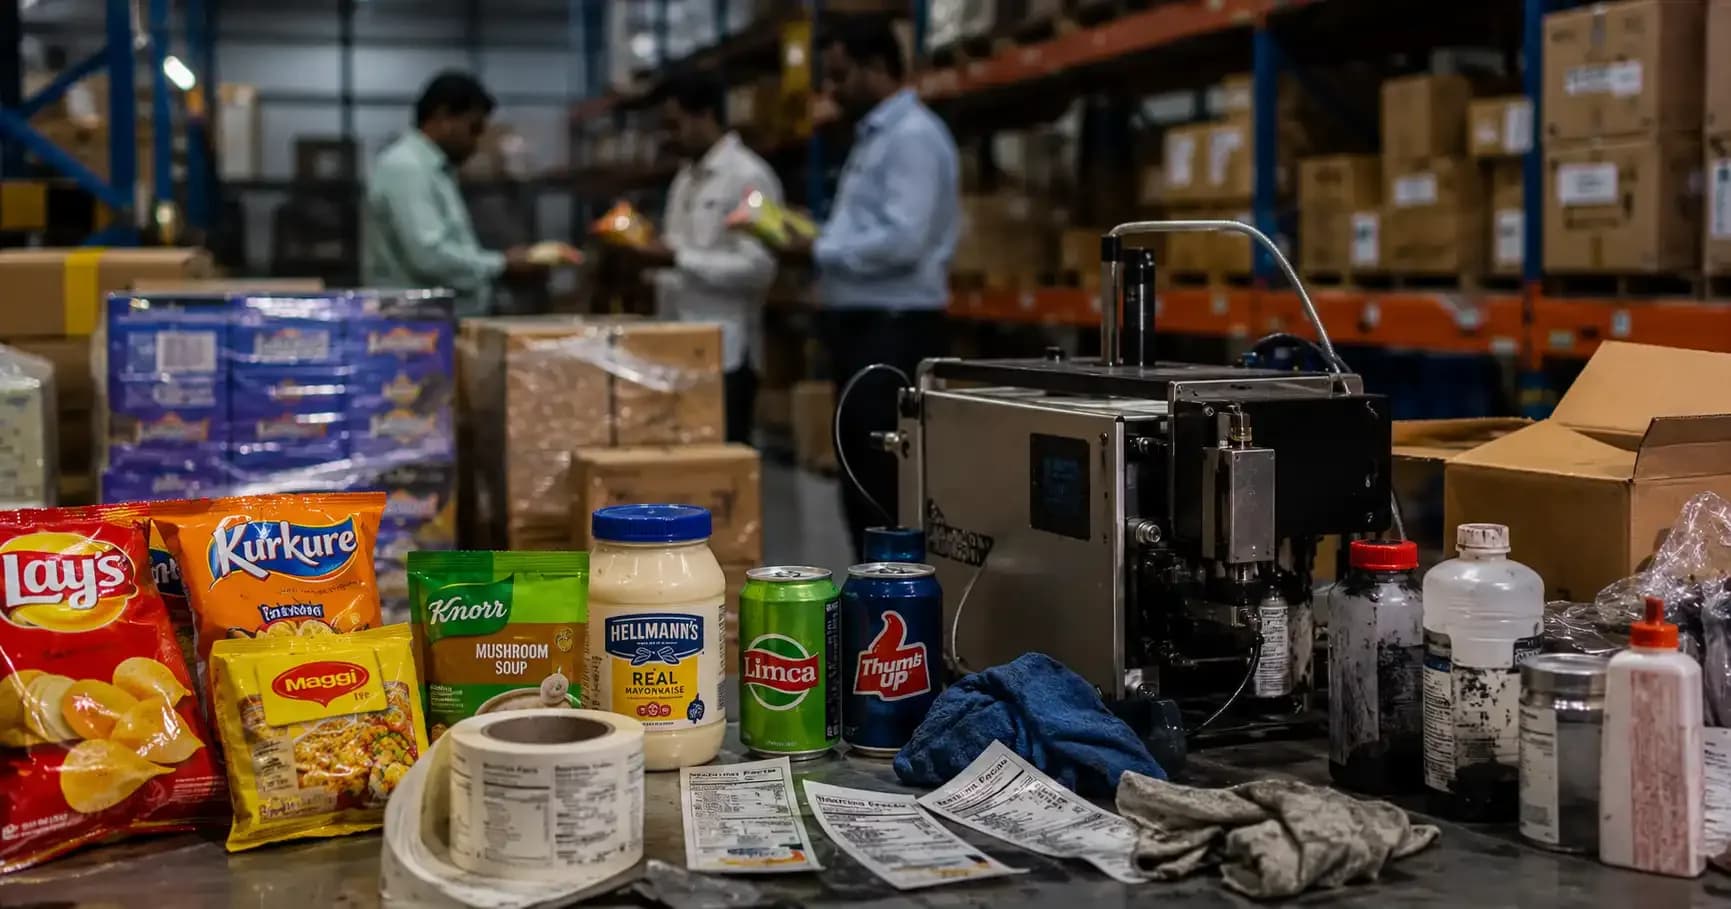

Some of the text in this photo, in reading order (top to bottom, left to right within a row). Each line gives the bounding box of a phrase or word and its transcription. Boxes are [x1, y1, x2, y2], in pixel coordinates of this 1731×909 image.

[214, 519, 358, 581] Kurkure
[3, 551, 125, 609] Lay's
[428, 597, 507, 625] Knorr
[611, 620, 699, 642] HELLMANN'S
[475, 643, 549, 660] MUSHROOM
[495, 660, 528, 675] SOUP
[632, 671, 678, 686] REAL
[744, 656, 817, 684] Limca
[284, 668, 358, 692] Maggi
